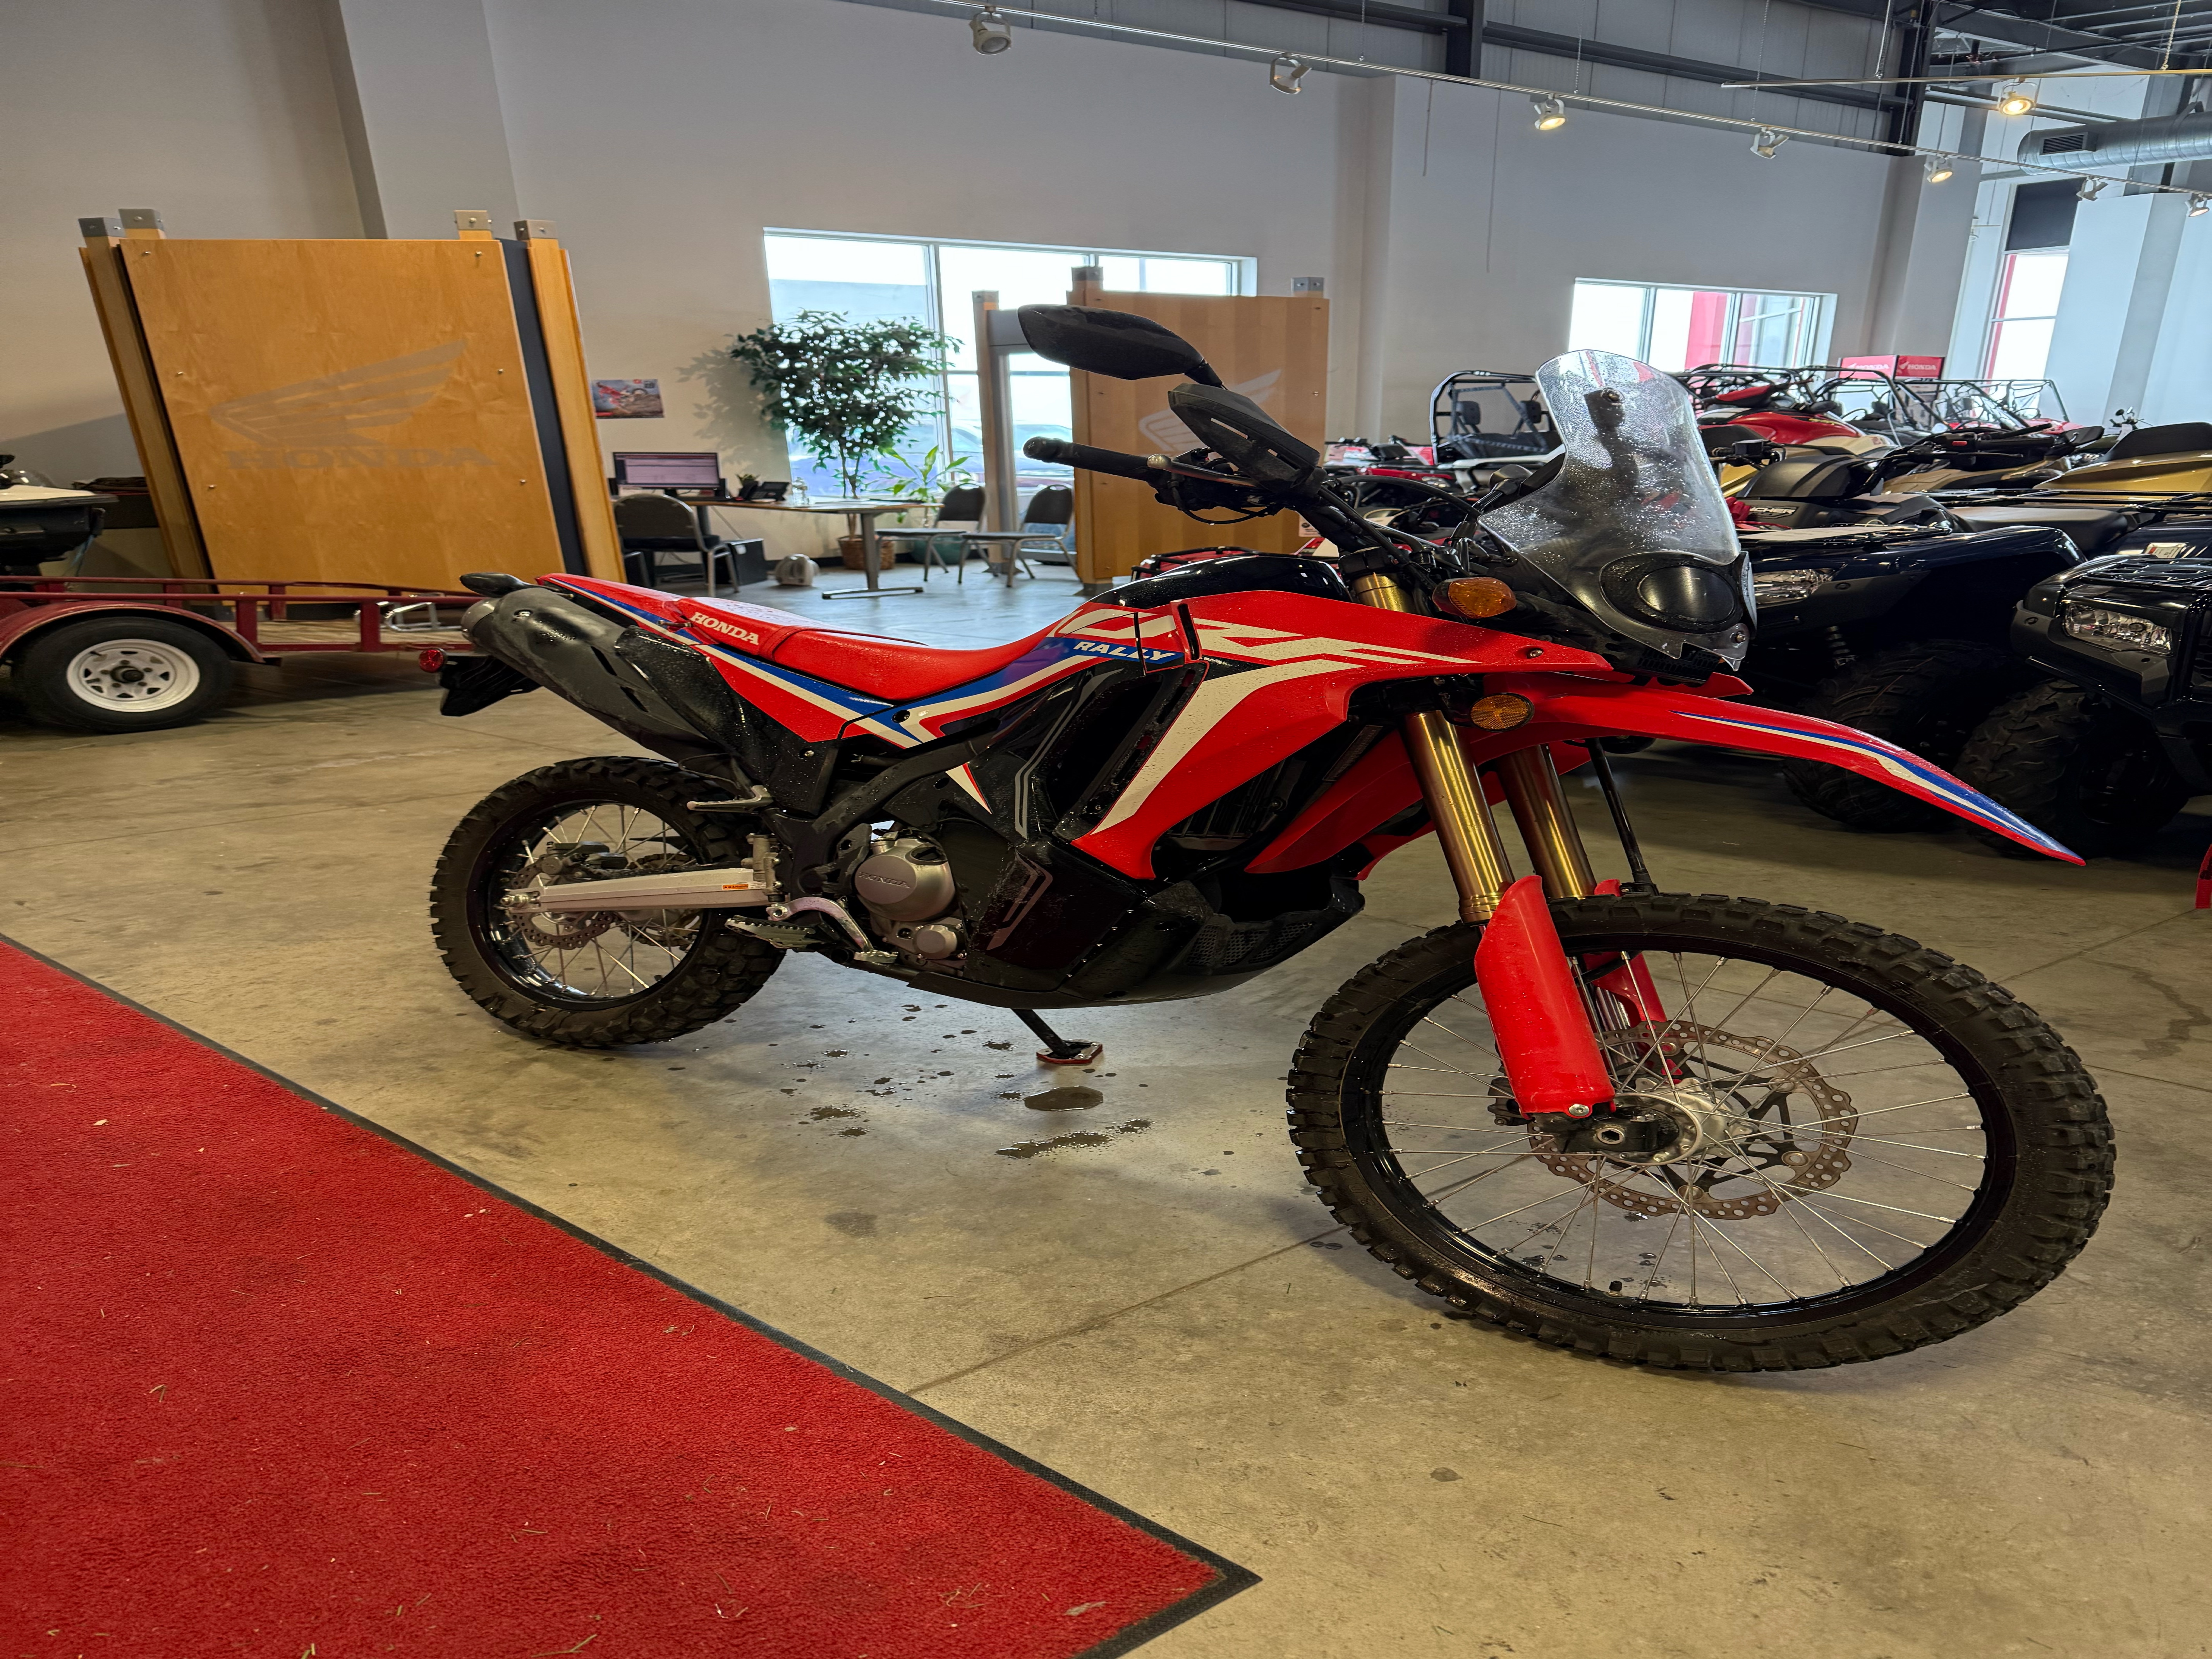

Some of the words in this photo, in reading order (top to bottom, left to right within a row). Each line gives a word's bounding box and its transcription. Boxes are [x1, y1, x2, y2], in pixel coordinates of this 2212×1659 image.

[224, 447, 499, 470] HONDA
[689, 611, 759, 645] HONDA
[1073, 641, 1176, 660] RALLY
[858, 871, 910, 888] HONDA
